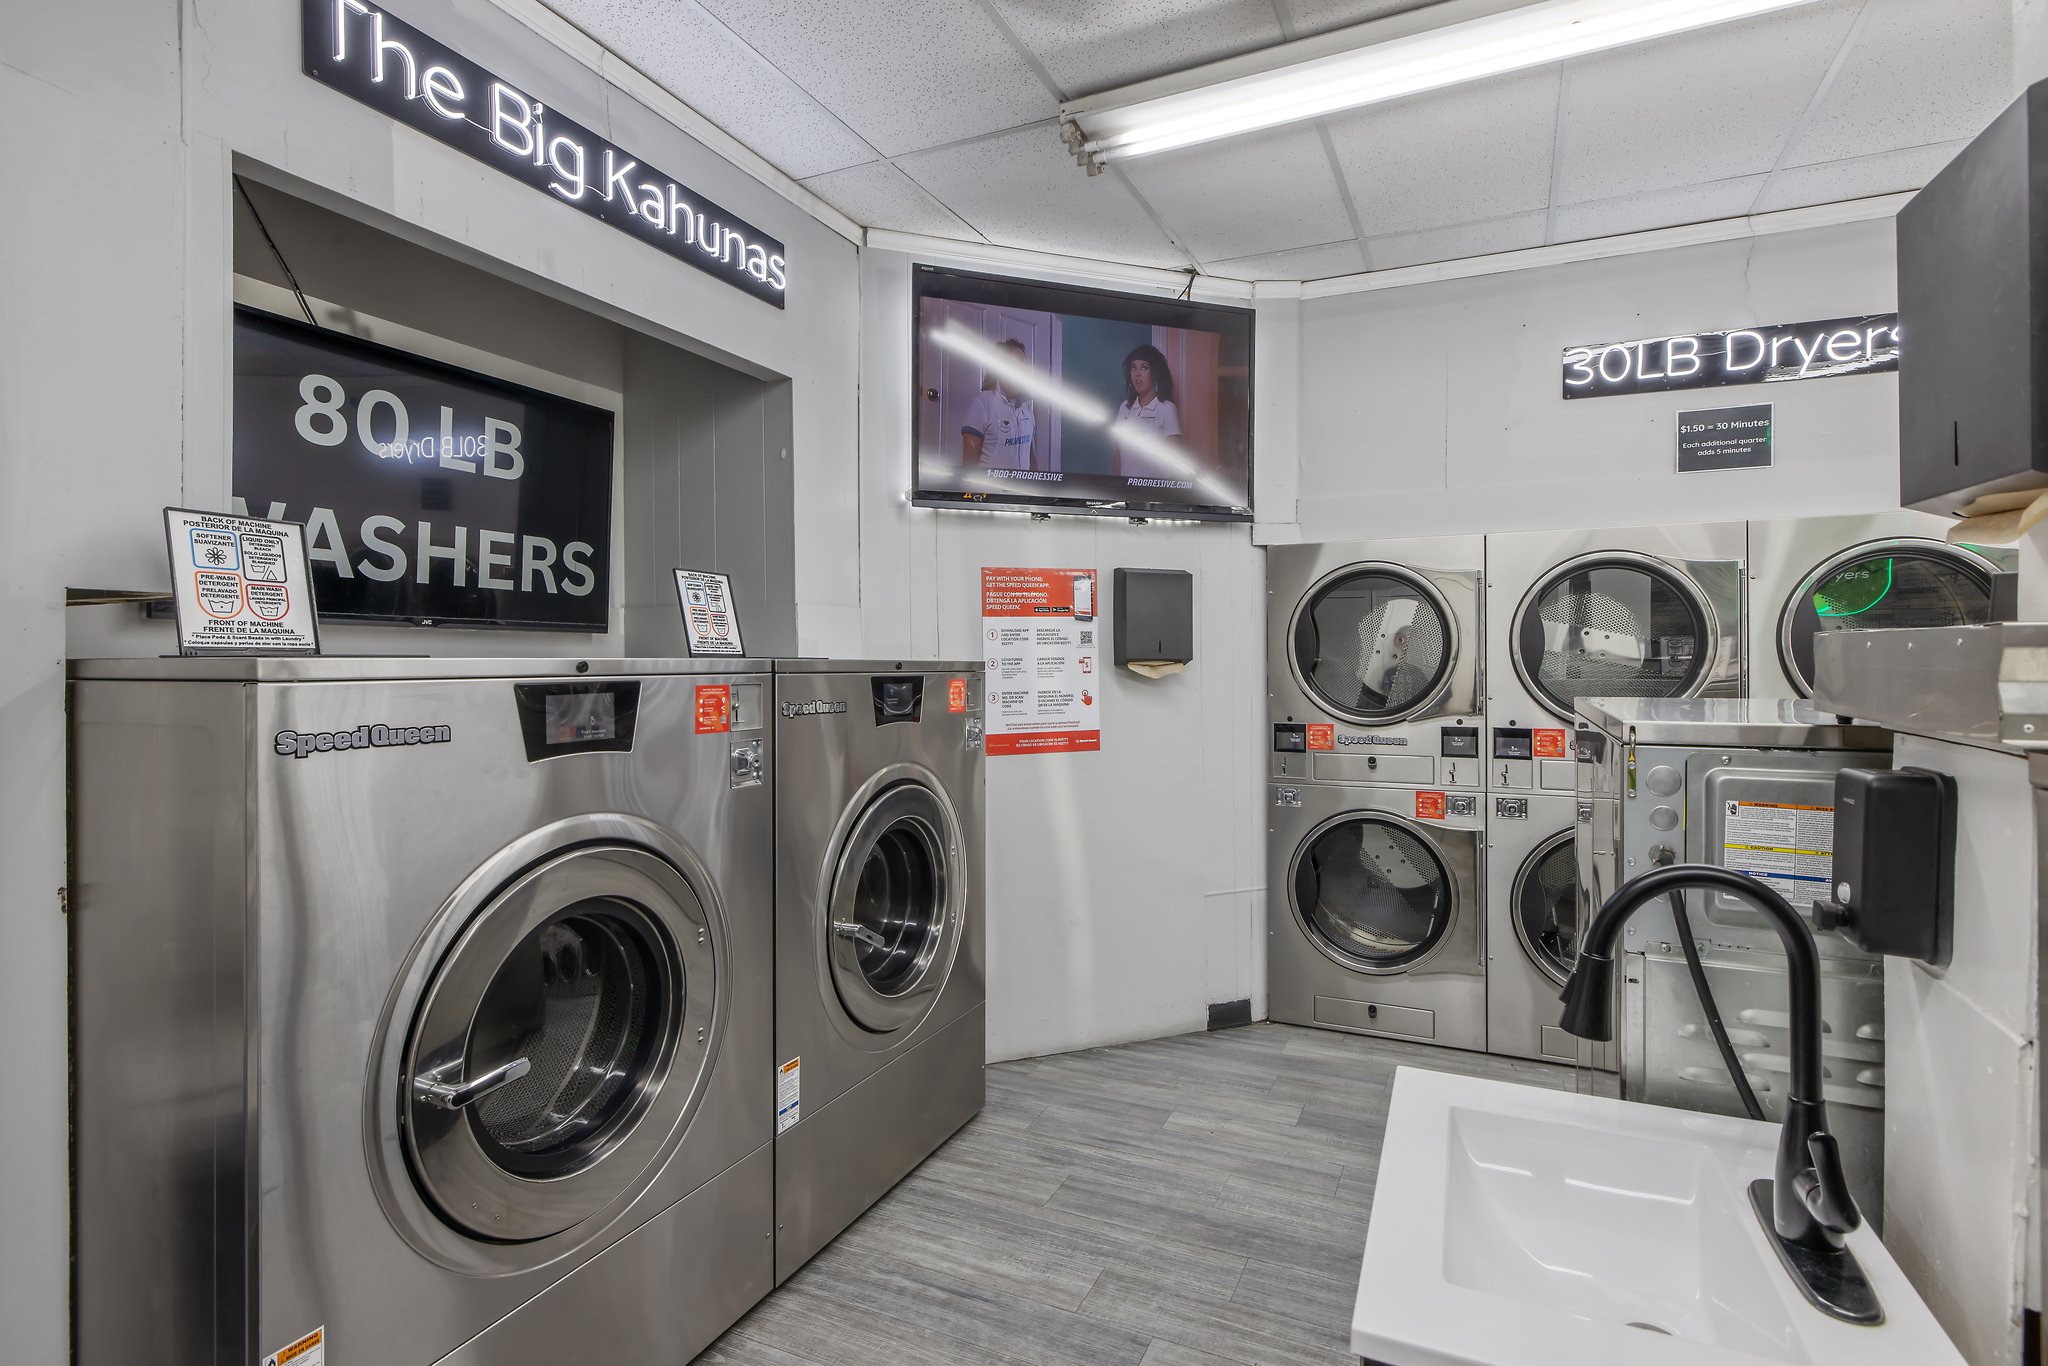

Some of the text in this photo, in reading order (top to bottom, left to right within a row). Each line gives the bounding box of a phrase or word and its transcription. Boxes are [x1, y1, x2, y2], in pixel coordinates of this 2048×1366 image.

[330, 0, 786, 290] The Big Kahunas
[1565, 336, 1701, 385] 30LB
[294, 373, 525, 481] 80 LB
[1680, 424, 1705, 434] $1.50
[1716, 422, 1729, 430] 30
[1731, 419, 1770, 429] Minutes
[1682, 436, 1766, 449] Each additional quarter
[986, 469, 1063, 482] 1-800-PROGRESSIVE
[1127, 478, 1193, 489] PROGRESSIVE.COM
[183, 520, 231, 531] POSTERIOR
[255, 528, 290, 538] MAQUINA
[201, 516, 224, 524] BACK
[238, 520, 272, 530] MACHINE
[194, 538, 235, 547] SUAVIZANTE
[196, 532, 232, 541] SOFTENER
[232, 496, 596, 597] ASHERS
[198, 580, 239, 588] DETERGENT
[208, 619, 235, 627] FRONT
[260, 627, 296, 635] MAQUINA
[782, 699, 848, 719] Speed Queen
[274, 723, 452, 759] Speed Queen
[287, 1332, 319, 1353] WARNING
